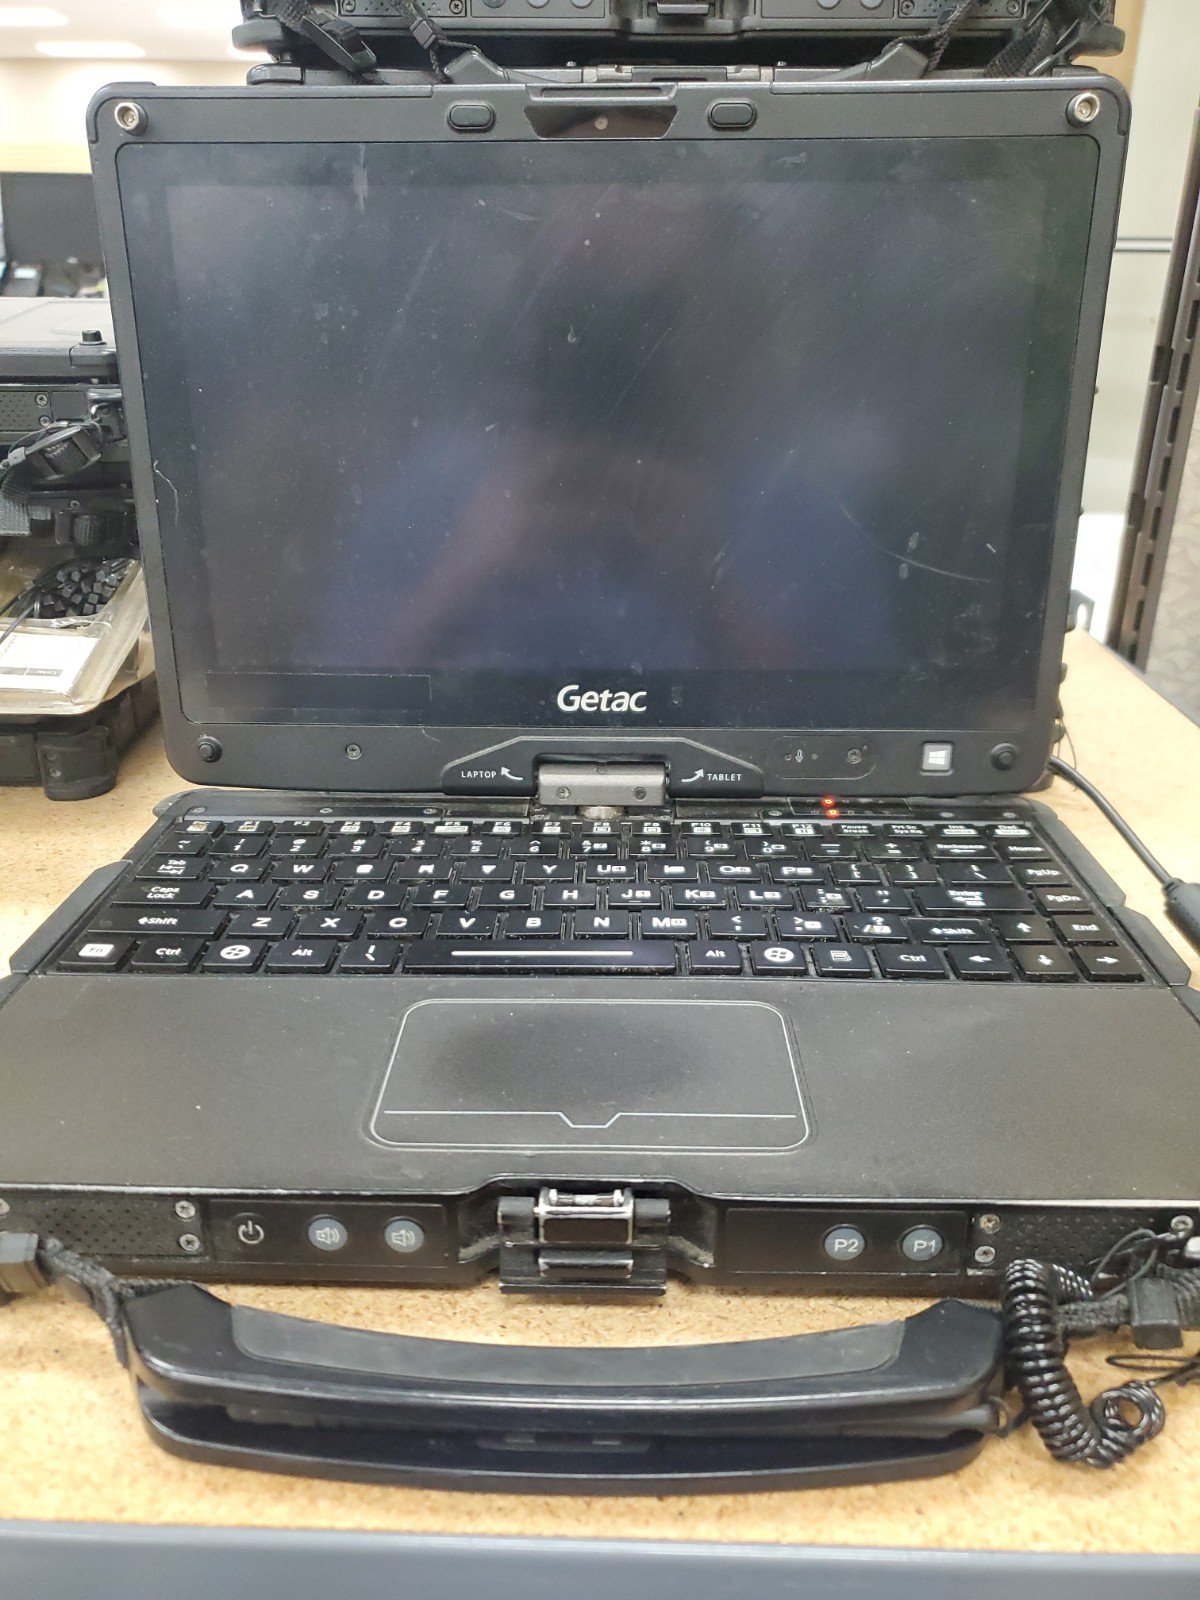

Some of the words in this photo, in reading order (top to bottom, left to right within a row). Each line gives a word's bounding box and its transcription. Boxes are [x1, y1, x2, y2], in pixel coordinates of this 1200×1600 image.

[557, 684, 647, 712] Getac
[461, 770, 497, 779] LAPTOP
[707, 773, 742, 782] TABLET
[230, 863, 249, 873] Q
[292, 864, 314, 874] W
[542, 864, 558, 874] Y
[597, 864, 611, 873] U
[719, 865, 735, 873] O
[781, 866, 796, 874] P
[1027, 868, 1060, 877] PgUp
[146, 891, 175, 899] Lock
[150, 886, 180, 894] Caps
[236, 889, 254, 899] A
[302, 889, 319, 899] S
[367, 889, 385, 900] D
[433, 889, 449, 899] F
[500, 889, 515, 900] G
[562, 889, 578, 899] H
[621, 889, 633, 898] J
[685, 889, 700, 899] K
[749, 890, 764, 900] L
[1047, 893, 1081, 903] PgDn
[147, 917, 178, 926] Shift
[252, 917, 272, 927] Z
[320, 917, 341, 928] X
[389, 917, 408, 928] C
[459, 917, 476, 928] V
[526, 917, 542, 927] B
[593, 917, 610, 927] N
[652, 917, 671, 927] M
[1072, 923, 1098, 931] End
[156, 947, 182, 956] Ctrl
[292, 949, 313, 957] Alt
[705, 949, 726, 958] Alt
[900, 954, 927, 962] Ctrl
[833, 1238, 859, 1253] P2
[913, 1239, 936, 1253] P1
